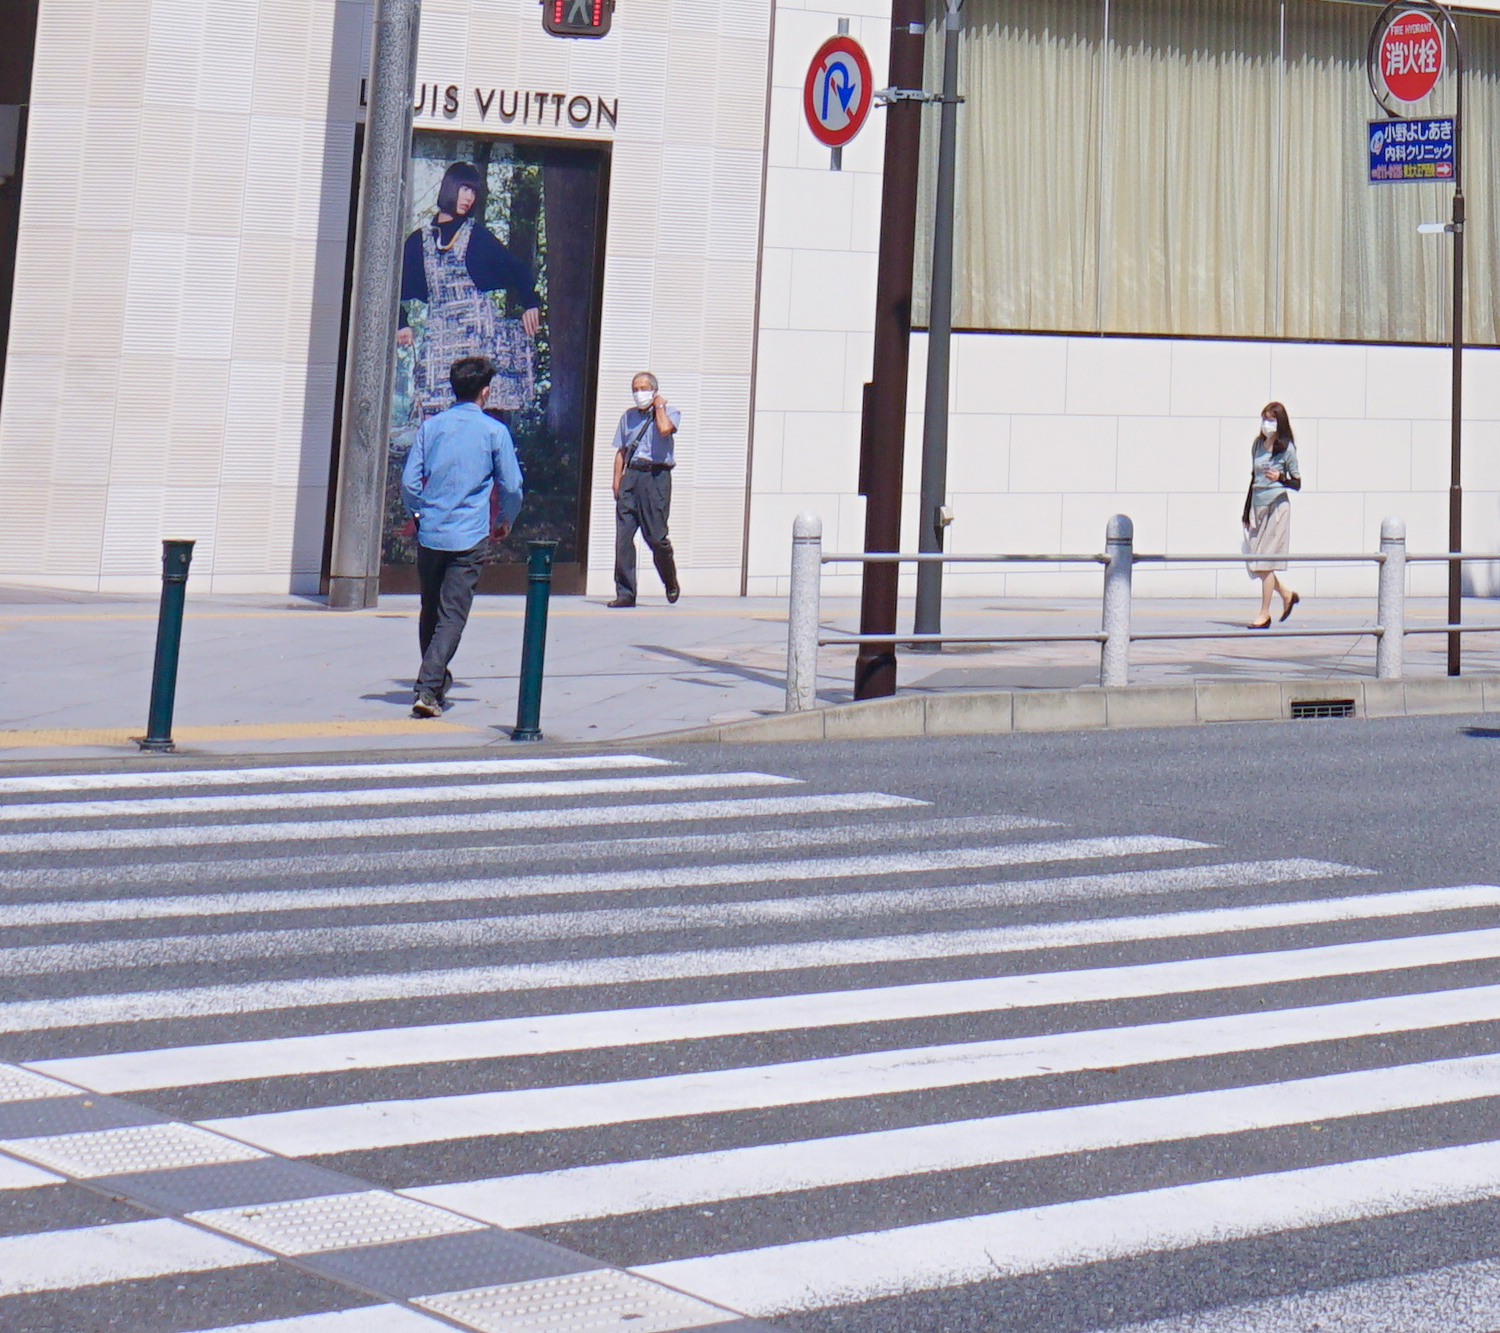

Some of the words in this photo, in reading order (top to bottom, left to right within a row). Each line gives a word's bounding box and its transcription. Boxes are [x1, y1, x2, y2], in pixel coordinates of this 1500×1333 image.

[1385, 38, 1438, 76] 消火栓
[359, 77, 459, 116] LUIS
[475, 86, 618, 129] VUITTON
[1384, 121, 1452, 143] 小野よしあき
[1384, 143, 1452, 162] 内科クリニック
